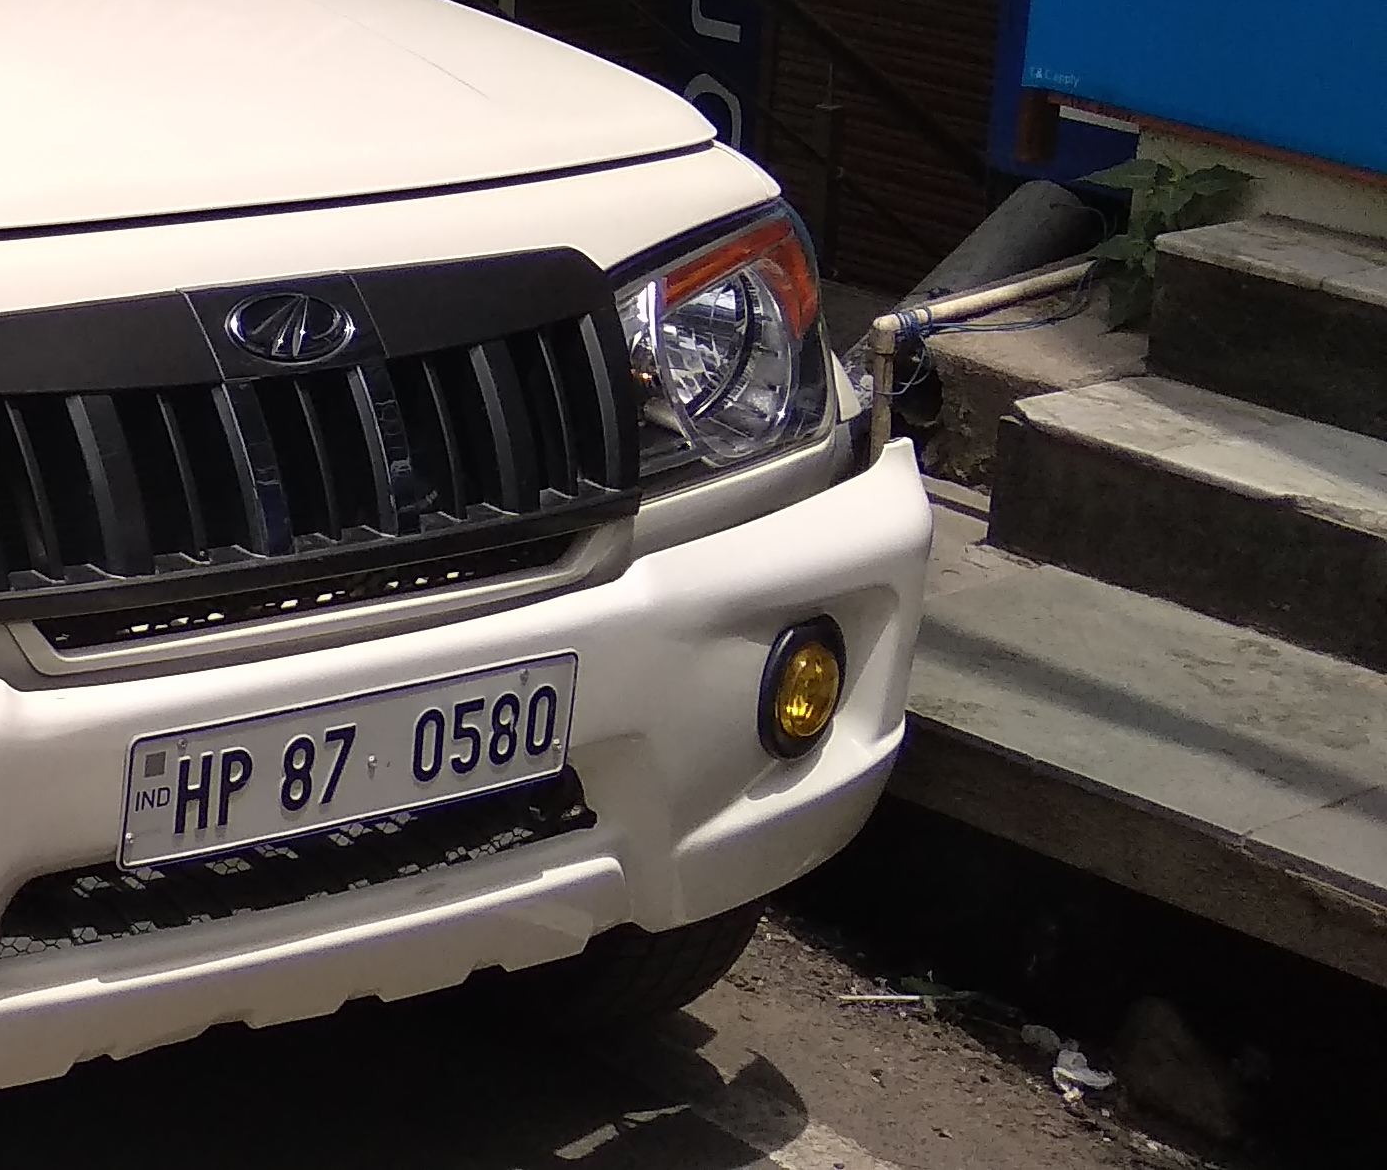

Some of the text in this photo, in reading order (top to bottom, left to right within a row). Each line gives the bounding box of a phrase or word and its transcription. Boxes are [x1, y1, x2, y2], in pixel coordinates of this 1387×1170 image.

[135, 786, 170, 812] IND
[173, 685, 557, 835] HP 87 0580
